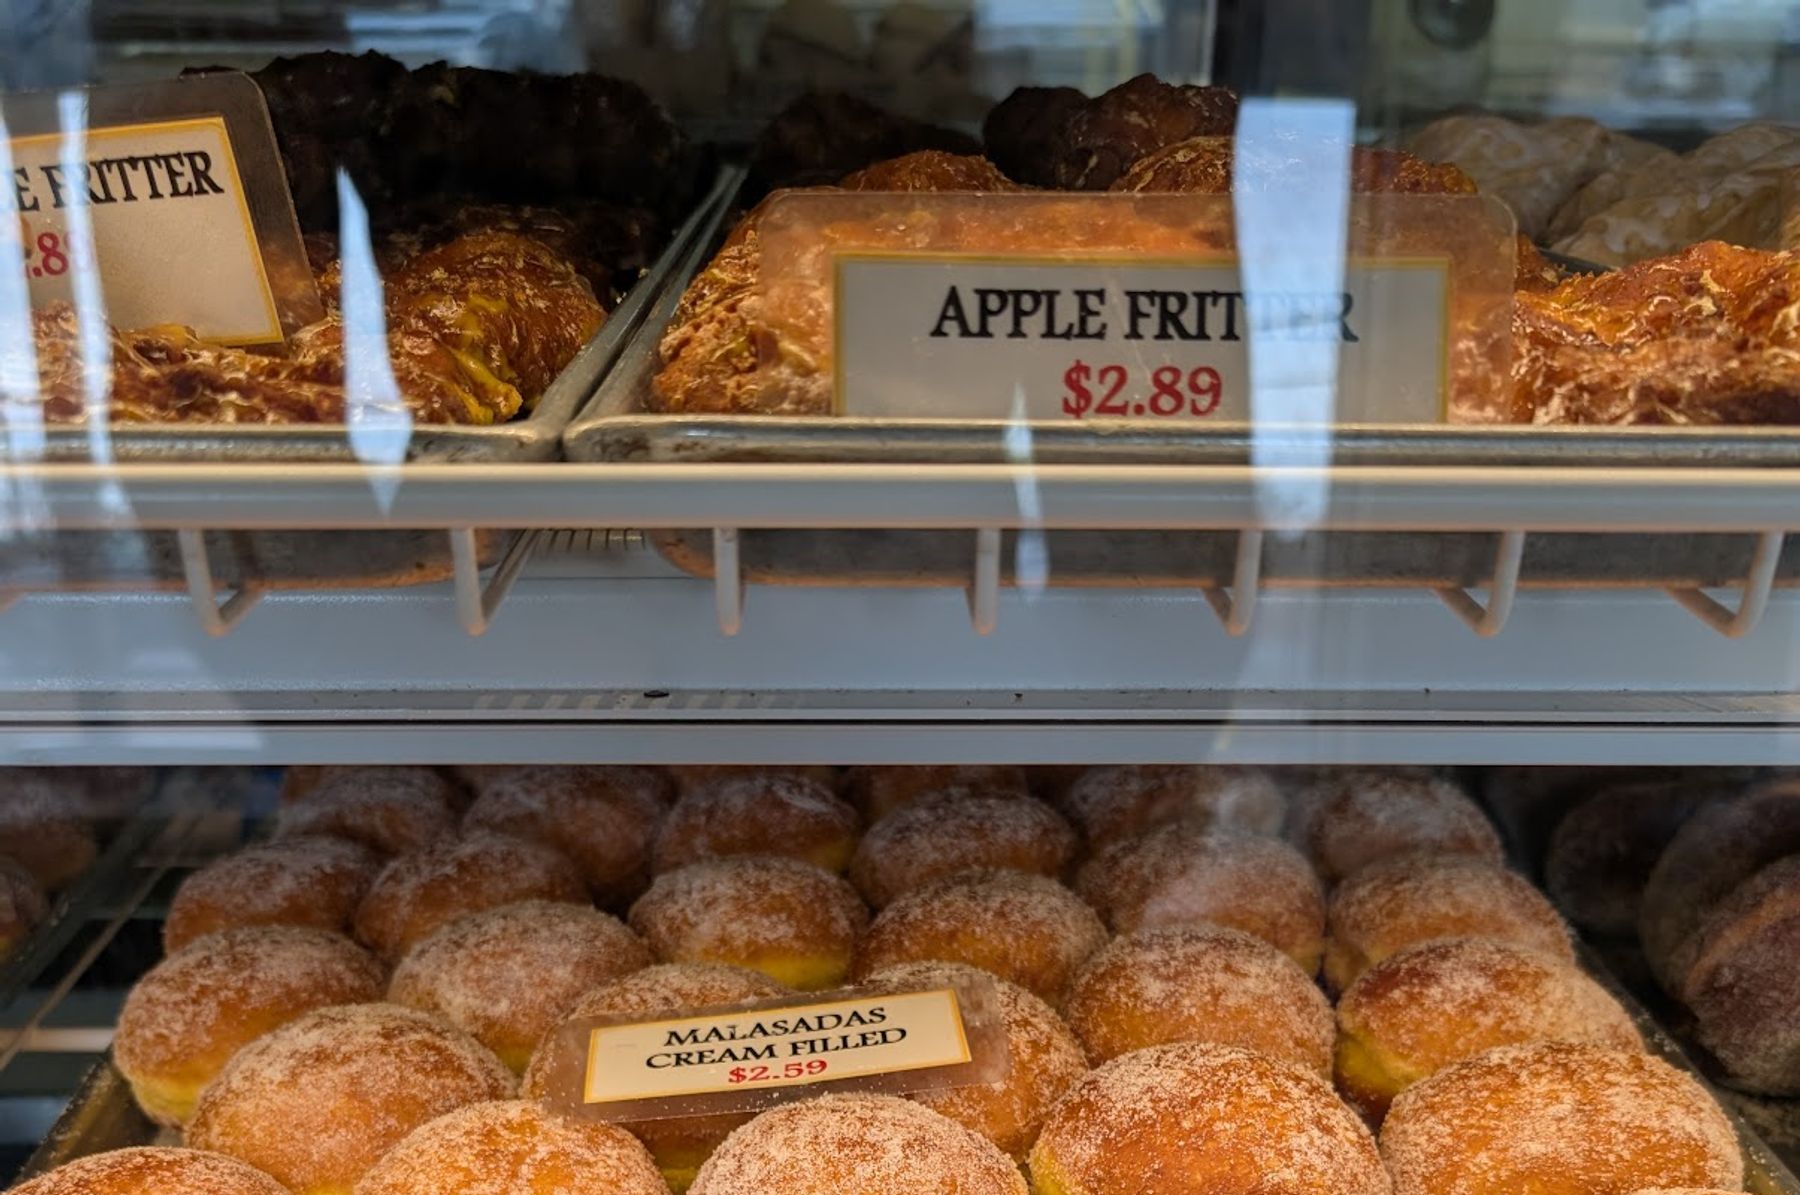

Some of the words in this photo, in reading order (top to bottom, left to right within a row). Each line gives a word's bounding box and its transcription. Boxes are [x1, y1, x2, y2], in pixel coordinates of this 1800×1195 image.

[930, 286, 1107, 341] APPLE
[1062, 359, 1222, 418] $2.89
[664, 1007, 886, 1046] MALASADAS
[646, 1043, 776, 1069] CREAM
[790, 1027, 907, 1057] FILLED
[728, 1060, 827, 1084] $2.59
